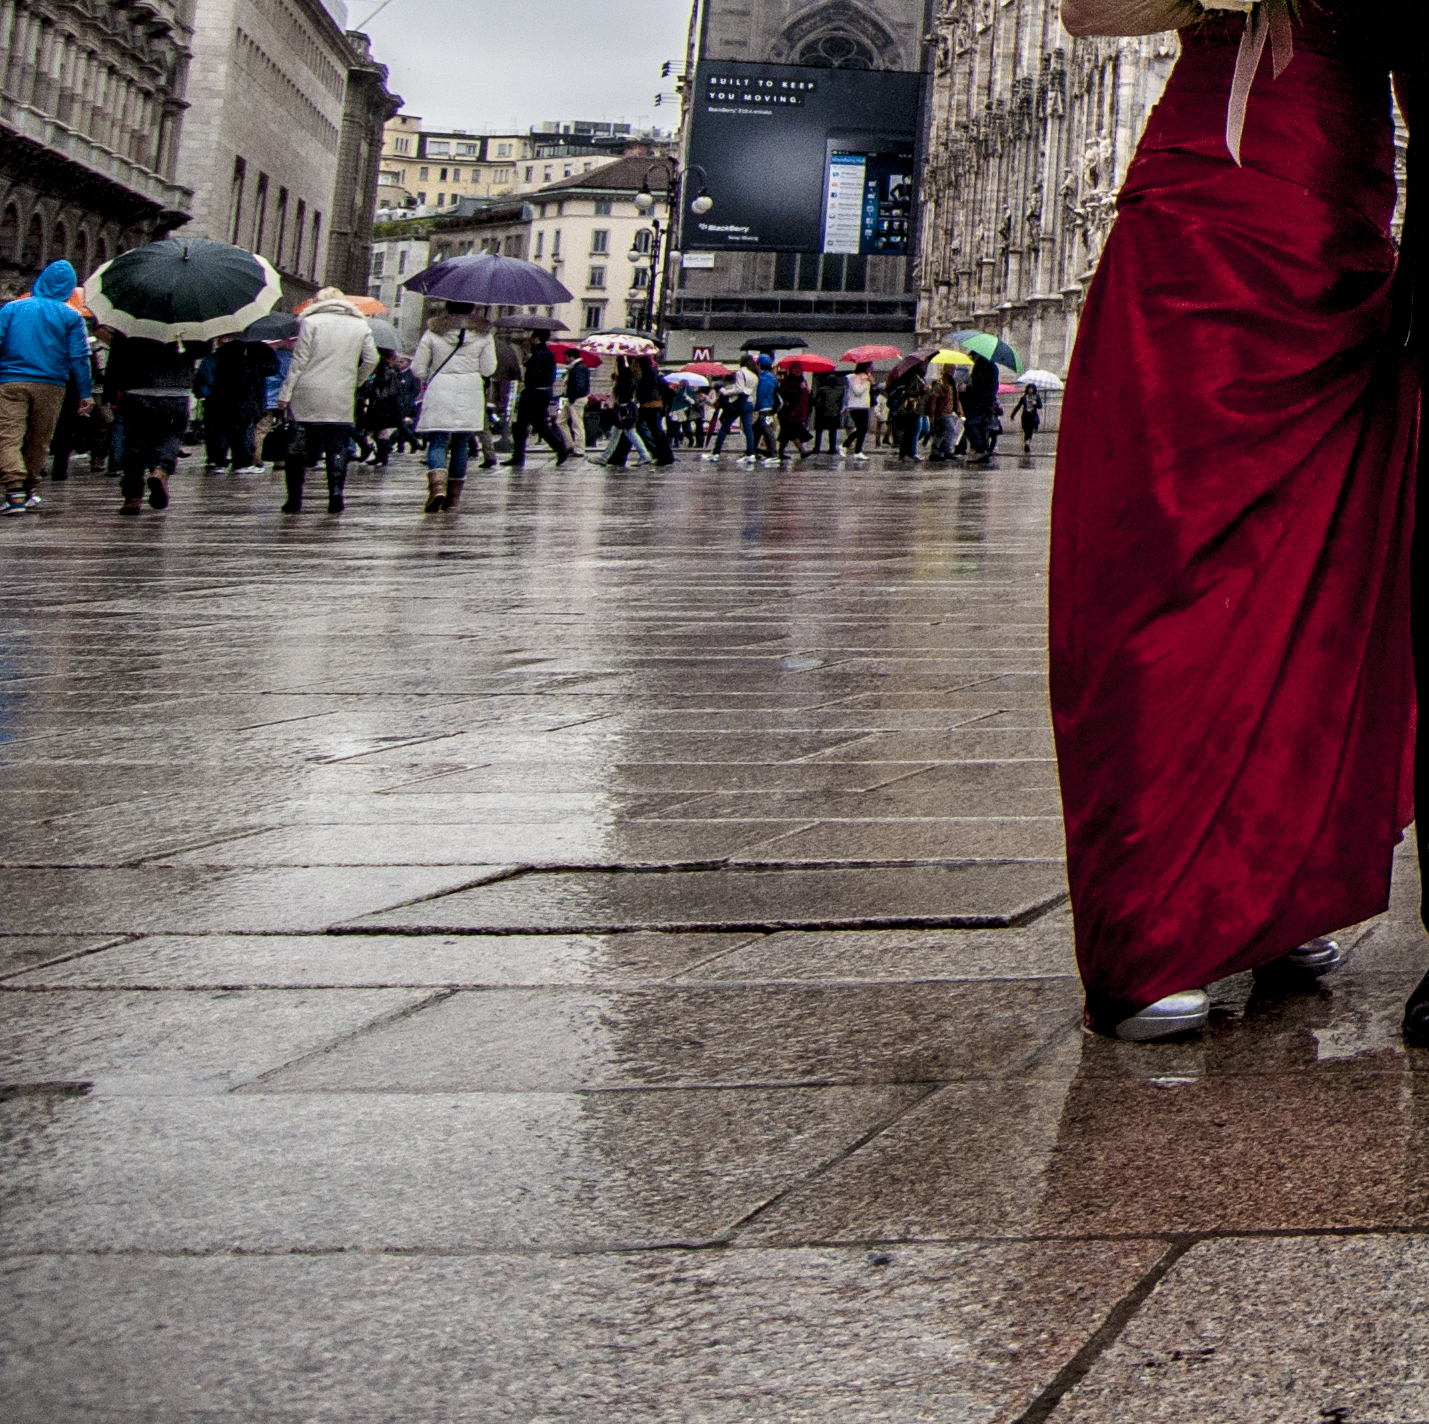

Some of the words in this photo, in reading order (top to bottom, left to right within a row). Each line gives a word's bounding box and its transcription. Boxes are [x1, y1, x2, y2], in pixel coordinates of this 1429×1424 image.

[709, 77, 749, 86] BUILT
[758, 79, 774, 87] TO
[781, 81, 814, 89] KEEP
[709, 92, 735, 100] YOU
[743, 94, 801, 104] MOVING.
[693, 349, 710, 361] M
